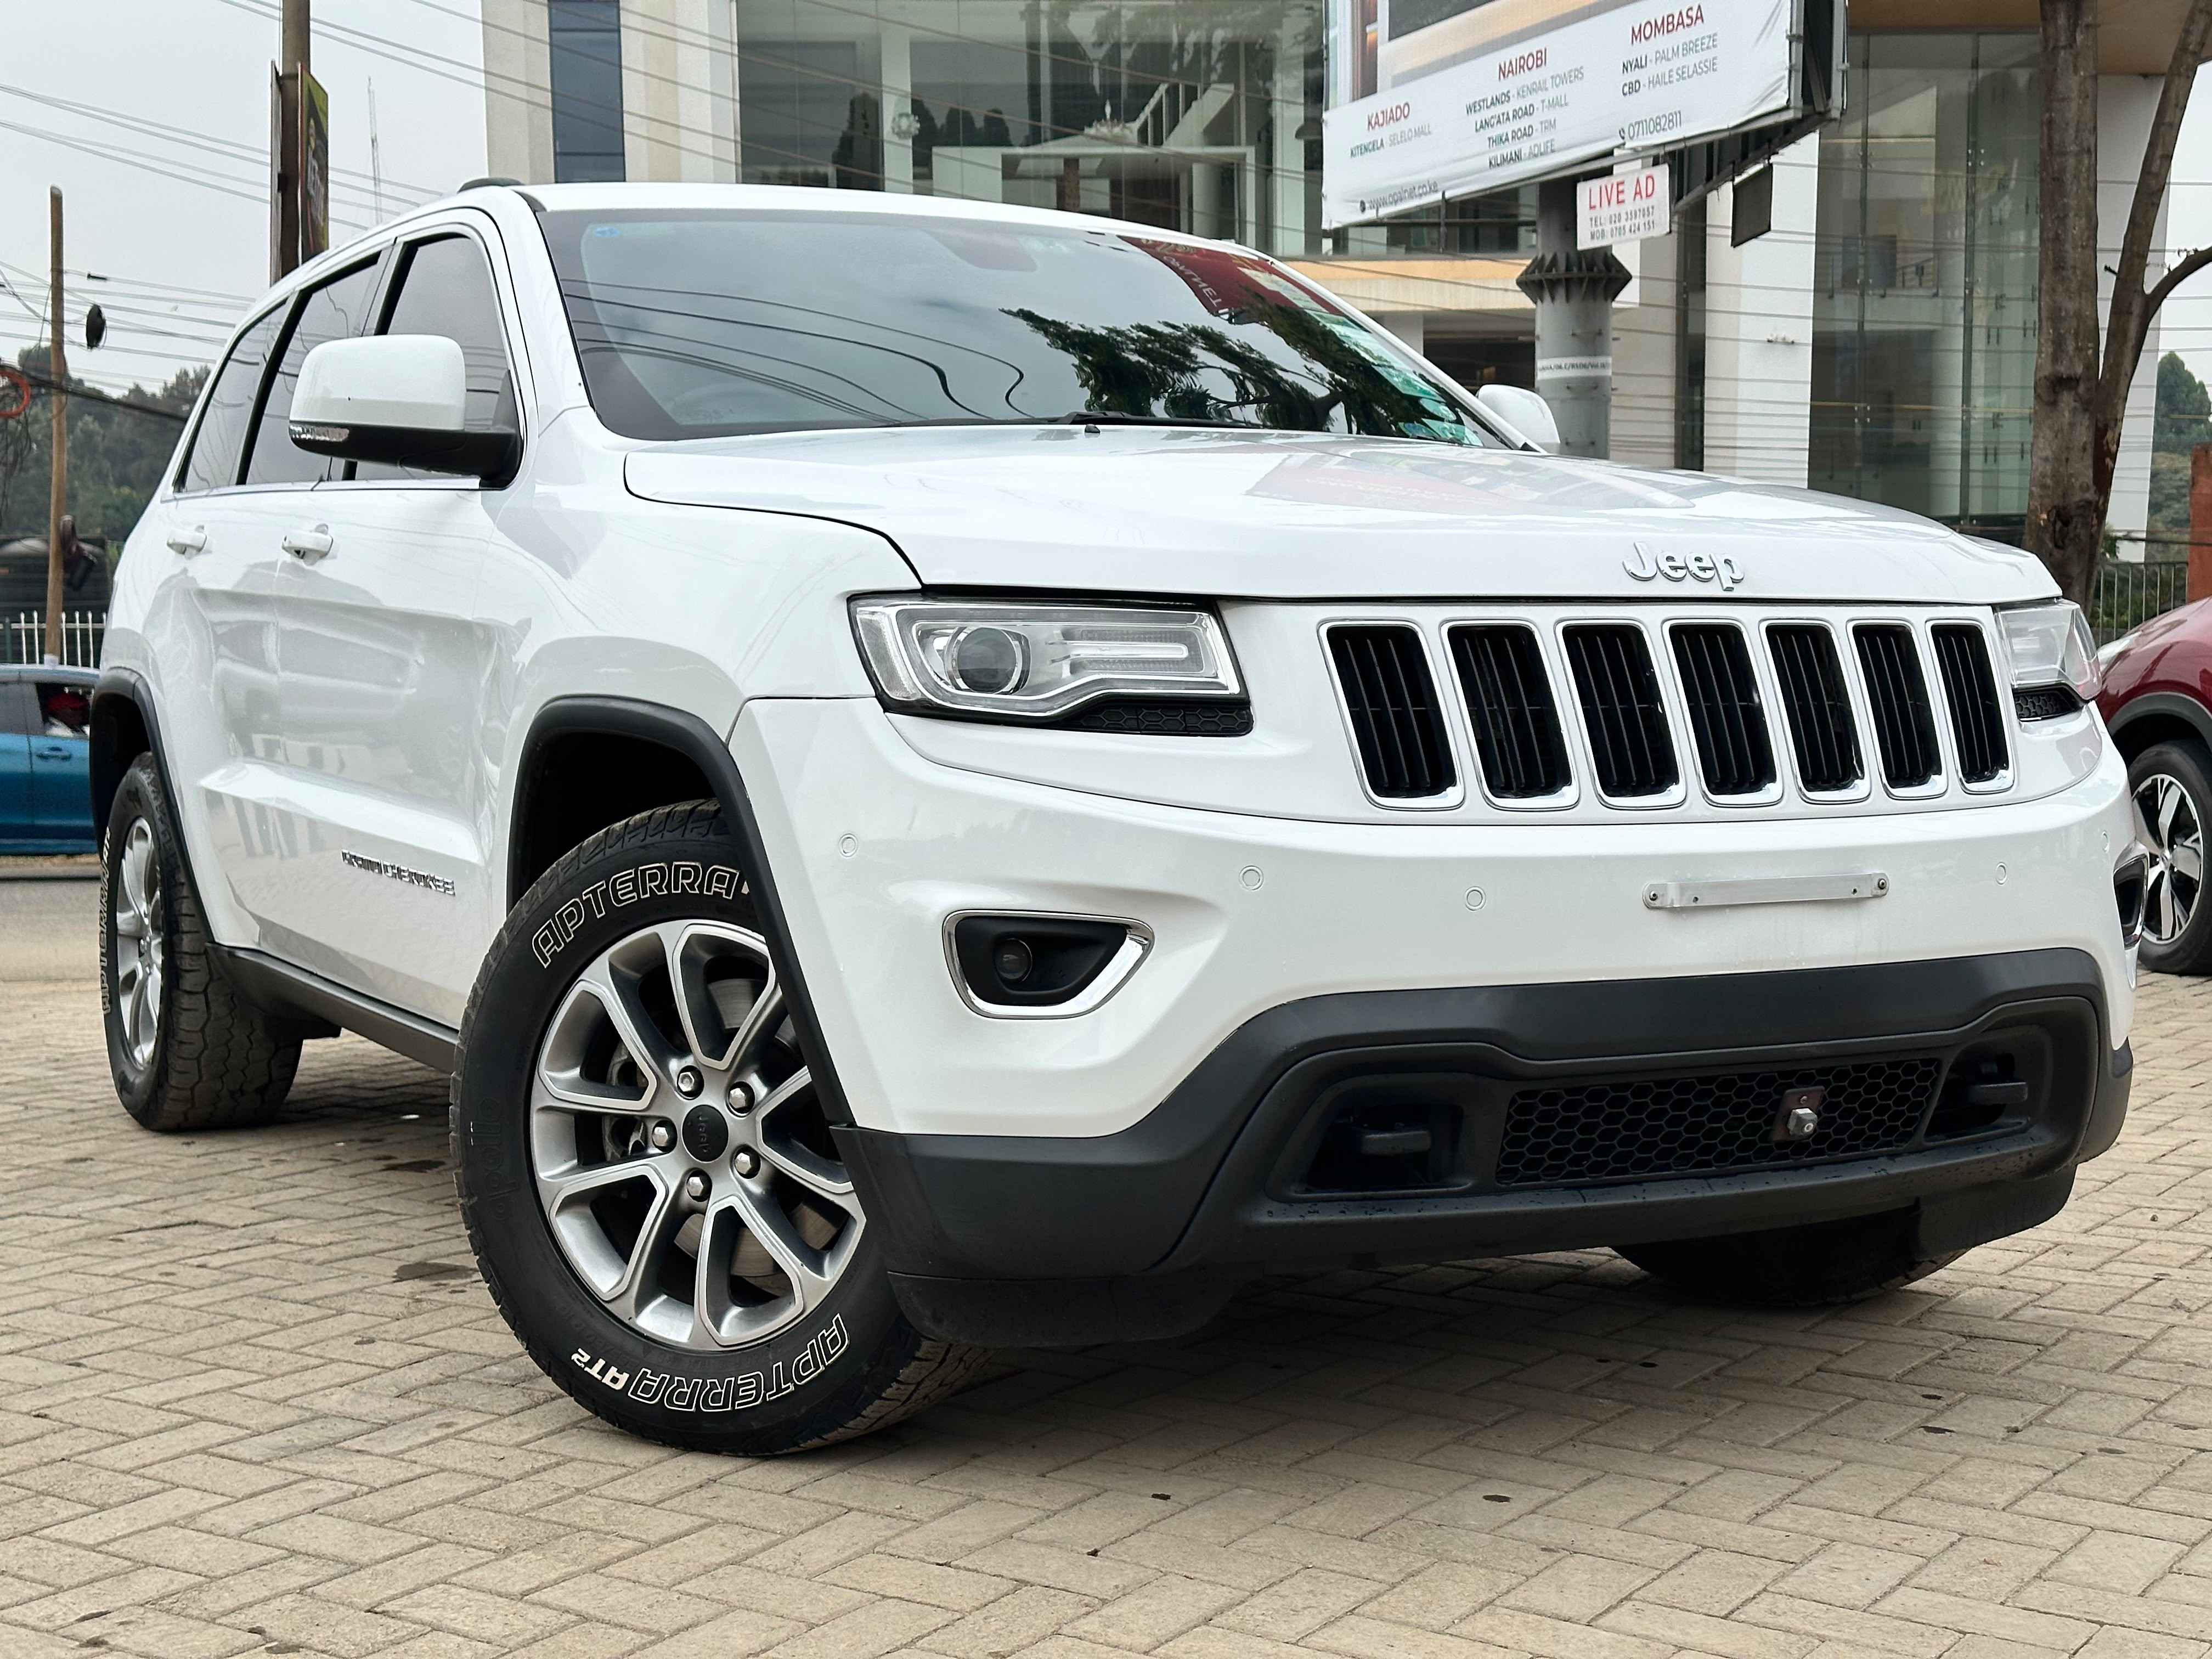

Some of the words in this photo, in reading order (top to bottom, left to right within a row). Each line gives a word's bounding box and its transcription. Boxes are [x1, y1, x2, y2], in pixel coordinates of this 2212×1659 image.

[1631, 3, 1704, 45] MOMBASA
[1498, 47, 1547, 82] NAIROBI
[1622, 54, 1647, 75] NYALI
[1655, 44, 1680, 65] PALM
[1681, 32, 1718, 57] BREEZE
[1465, 90, 1511, 115] WESTLANDS
[1516, 78, 1549, 100] KENRAIL
[1550, 66, 1584, 89] TOWERS
[1622, 79, 1641, 97] CBD
[1647, 69, 1673, 90] HAILE
[1675, 56, 1718, 82] SELASSIE
[1367, 101, 1410, 132] KAJIADO
[1475, 111, 1510, 133] LANG'ATA
[1512, 103, 1534, 122] ROAD
[1541, 93, 1569, 112] T-MALL
[1487, 131, 1510, 149] THIKA
[1511, 124, 1534, 143] ROAD
[1540, 117, 1556, 134] TRM
[1628, 110, 1682, 140] 0711082811
[1389, 128, 1413, 147] SELELO
[1414, 122, 1432, 138] MALL
[1489, 147, 1522, 169] KILIMANI
[1528, 139, 1555, 160] ADLIFE
[1589, 179, 1625, 210] LIVE
[1633, 174, 1655, 202] AD
[1622, 541, 1745, 591] Jeep
[383, 860, 456, 896] CHEROKEE
[531, 861, 741, 969] APTERRA
[99, 860, 111, 1015] APTERRA
[570, 1347, 629, 1391] AT2
[628, 1313, 850, 1413] APTERRA
